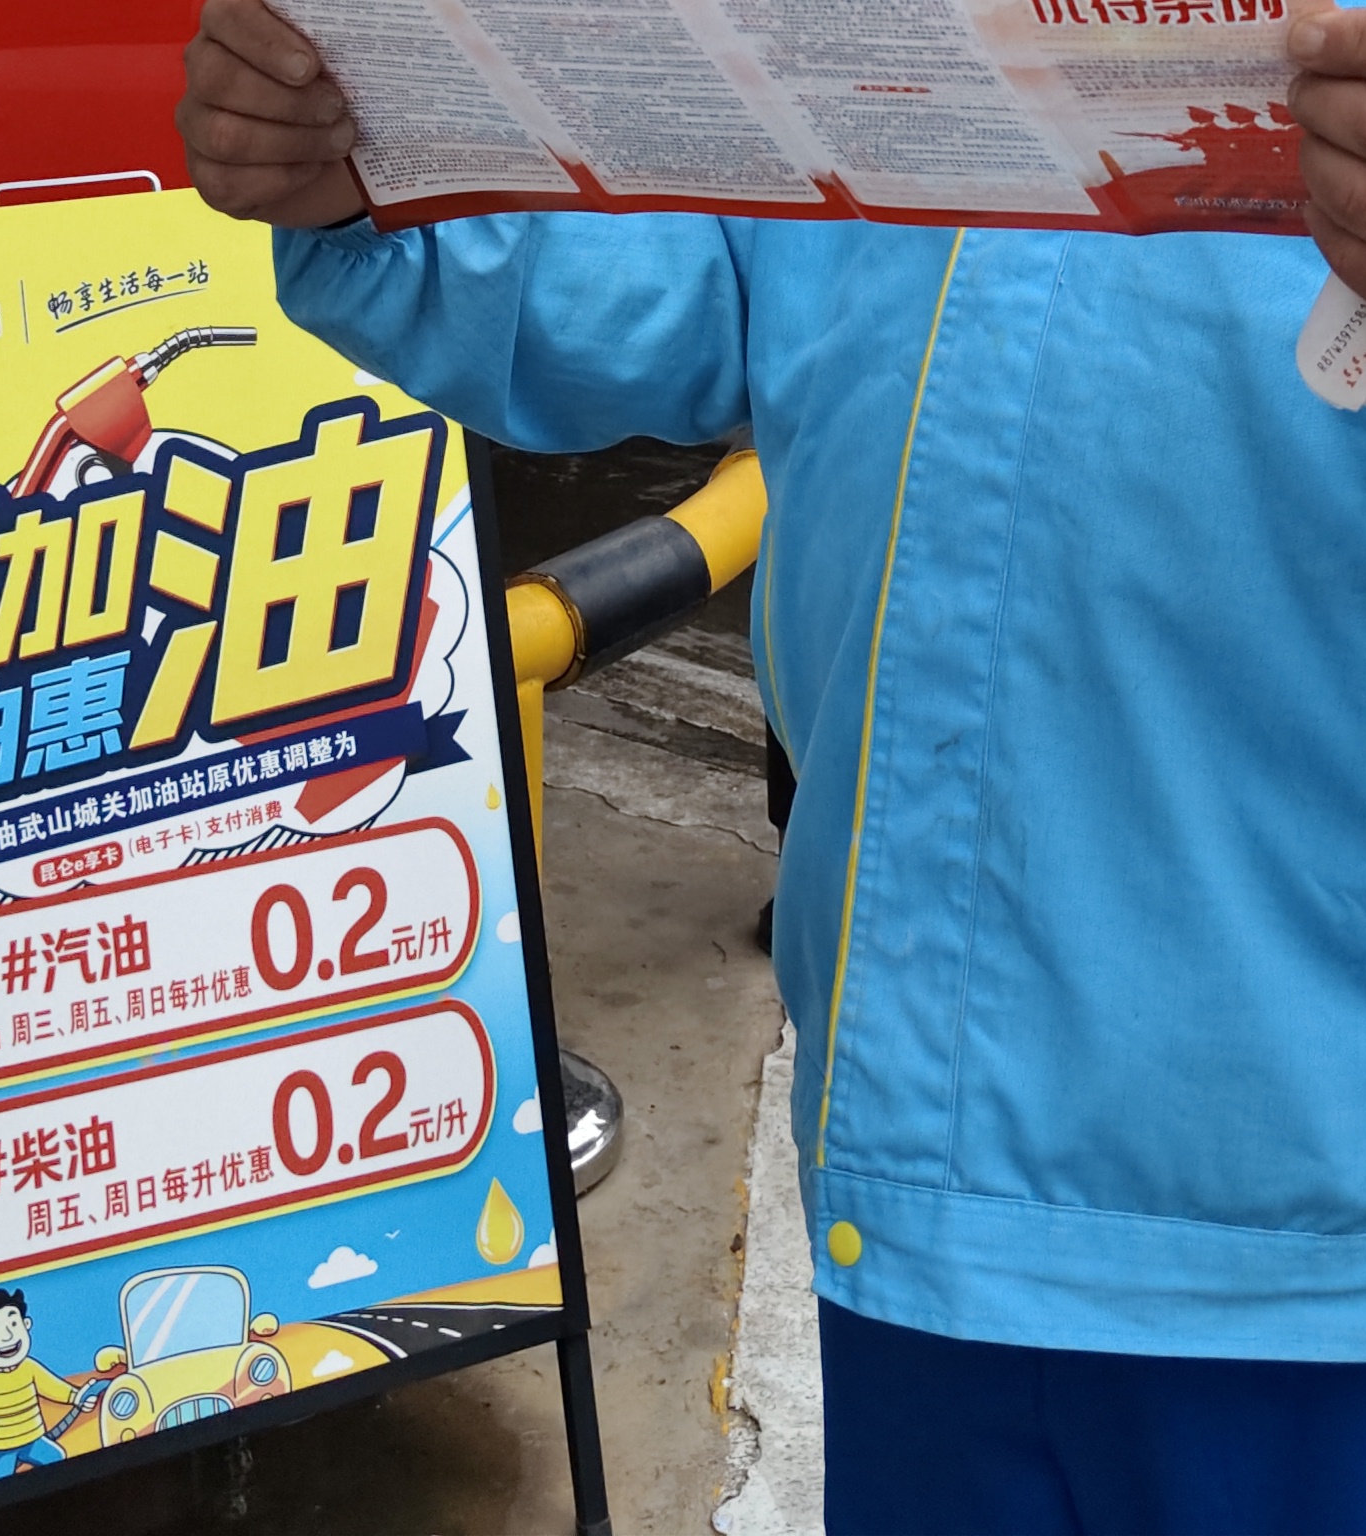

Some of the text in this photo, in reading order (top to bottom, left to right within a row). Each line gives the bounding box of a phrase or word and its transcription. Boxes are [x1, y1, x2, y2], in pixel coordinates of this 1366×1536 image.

[46, 259, 212, 320] 畅享生活每一站
[37, 844, 120, 886] 昆仑e享卡
[250, 864, 455, 994] 0.2元/升
[10, 965, 253, 1048] 周三、周五、周日每升优惠
[271, 1049, 469, 1179] 0.2元/升
[25, 1145, 276, 1243] 周五、周日每升优惠
